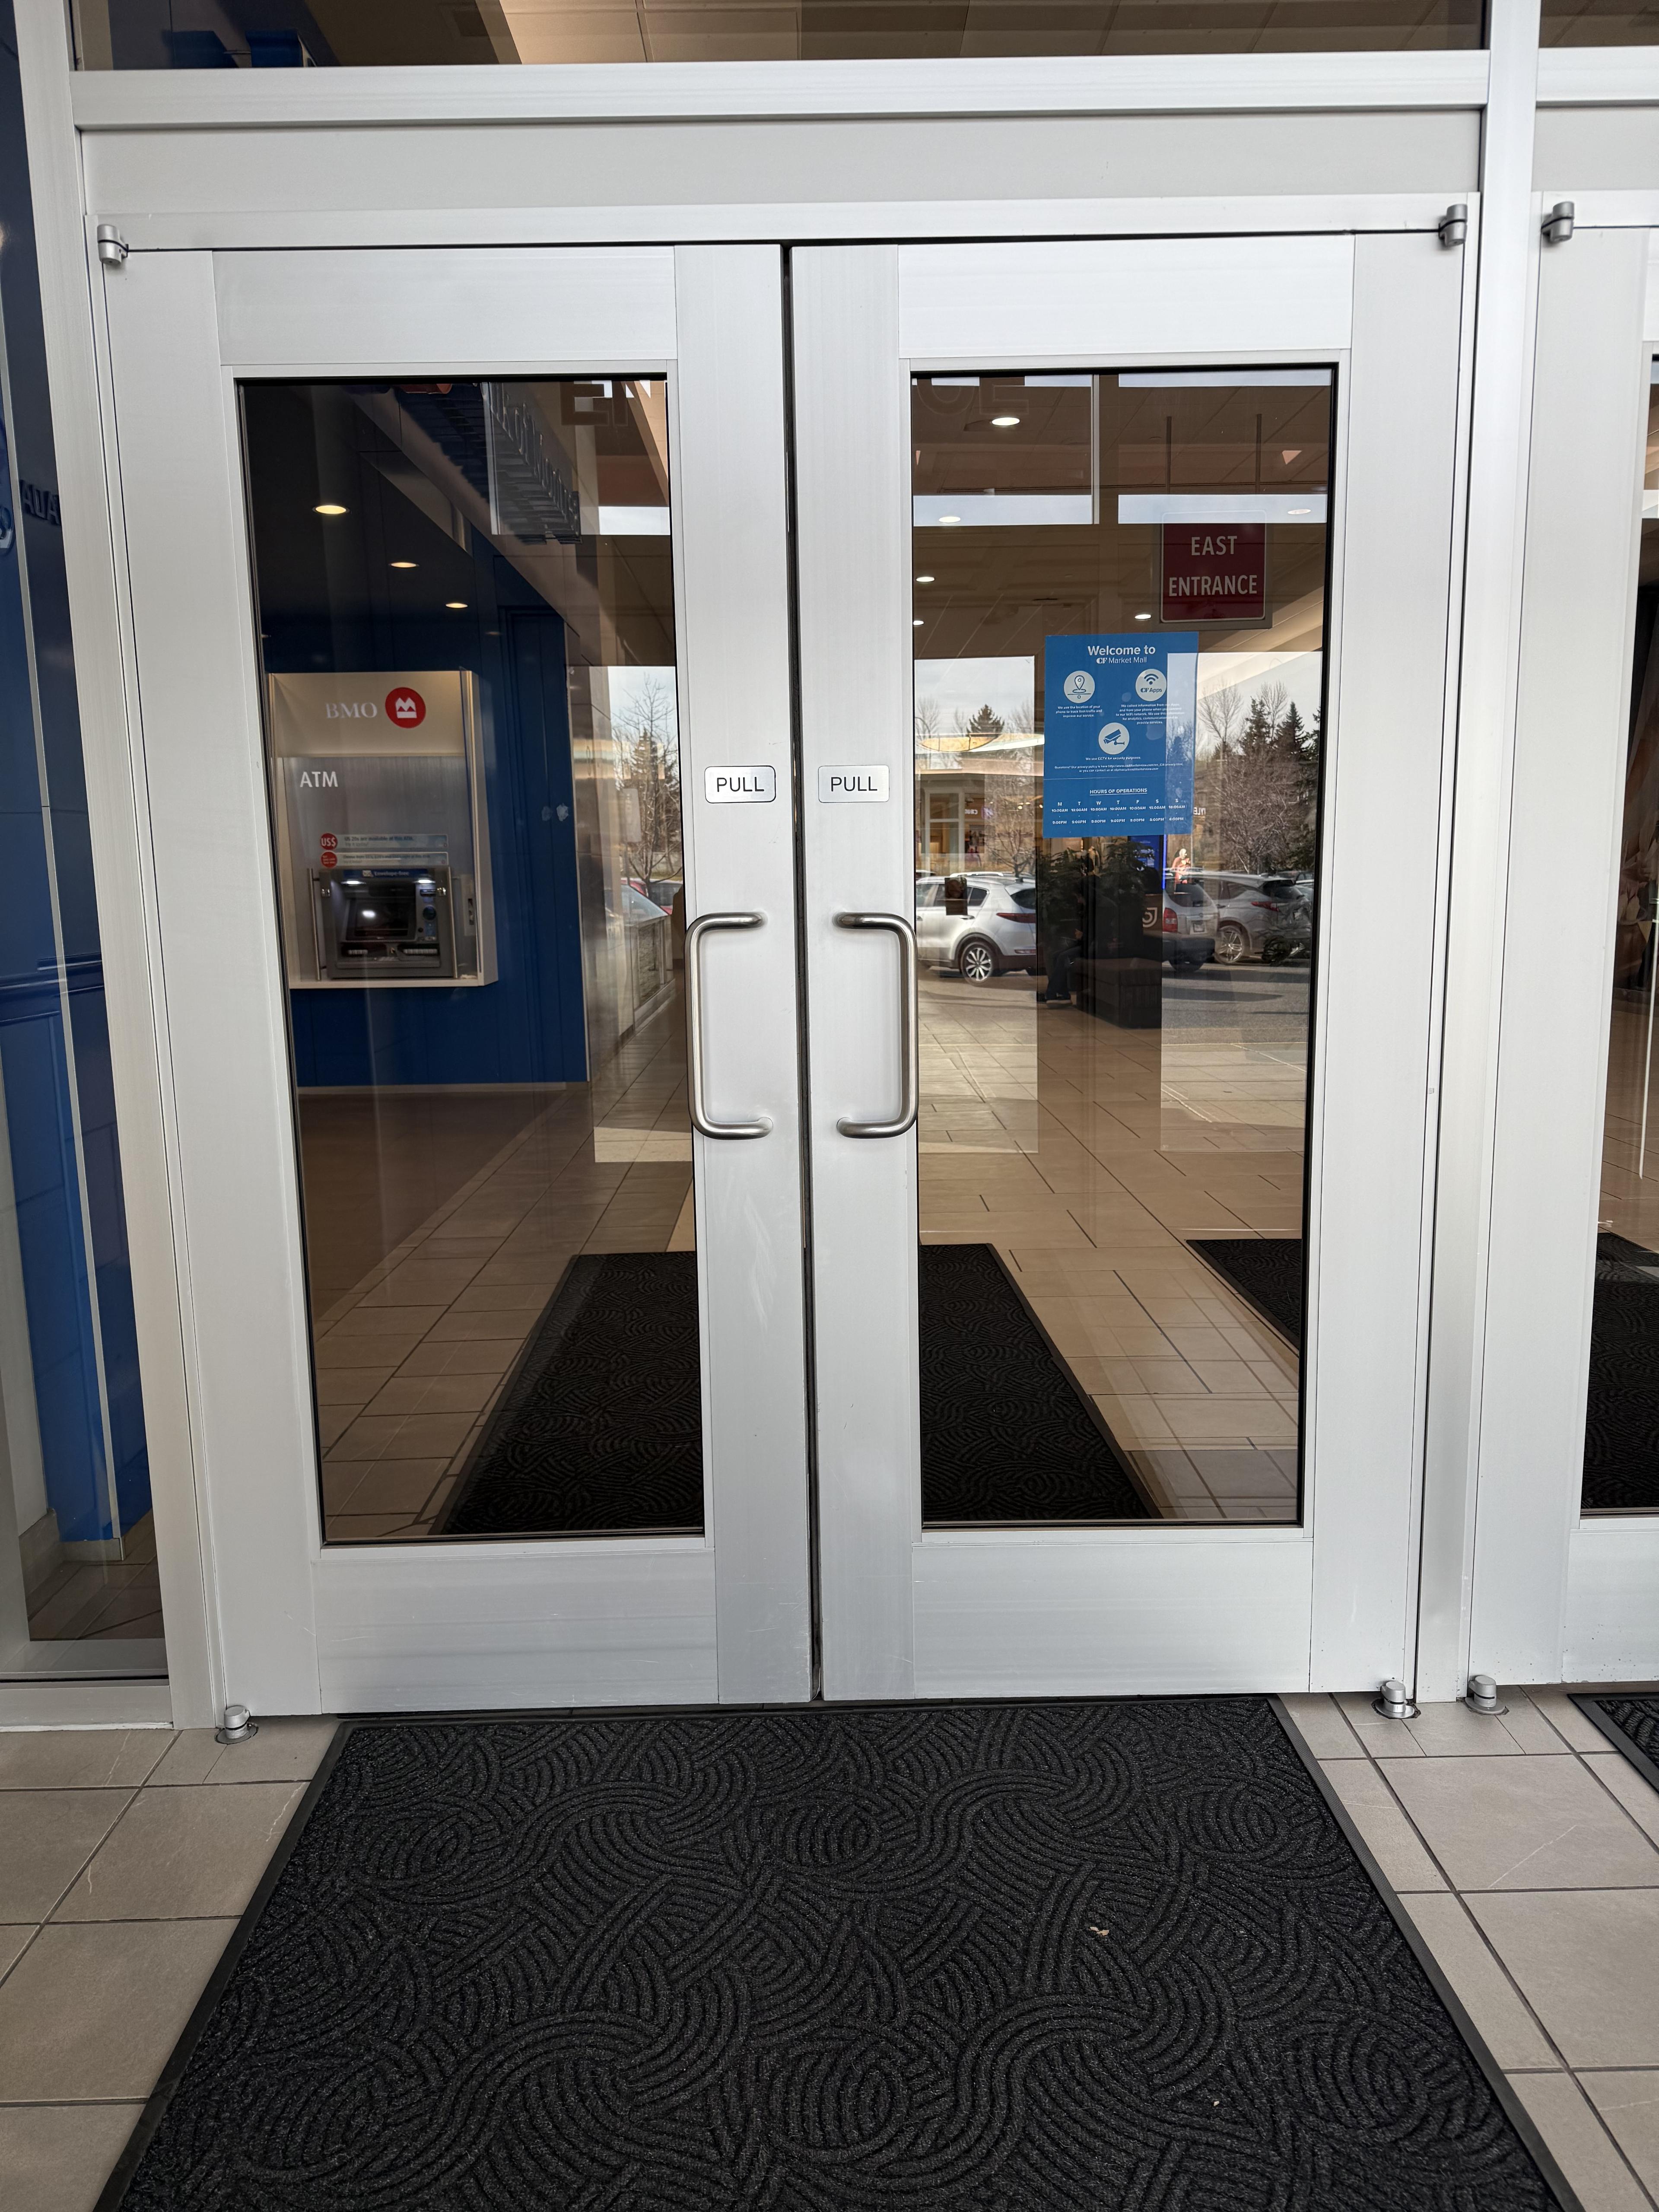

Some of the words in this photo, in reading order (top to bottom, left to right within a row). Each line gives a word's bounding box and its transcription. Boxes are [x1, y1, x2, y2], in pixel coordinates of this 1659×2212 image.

[1192, 536, 1237, 556] EAST
[1169, 575, 1258, 597] ENTRANCE
[1087, 645, 1141, 656] Welcome
[1144, 645, 1156, 655] to
[326, 702, 378, 718] BMO
[300, 771, 338, 788] ATM
[716, 777, 765, 792] PULL
[830, 776, 878, 792] PULL
[321, 837, 337, 847] US$
